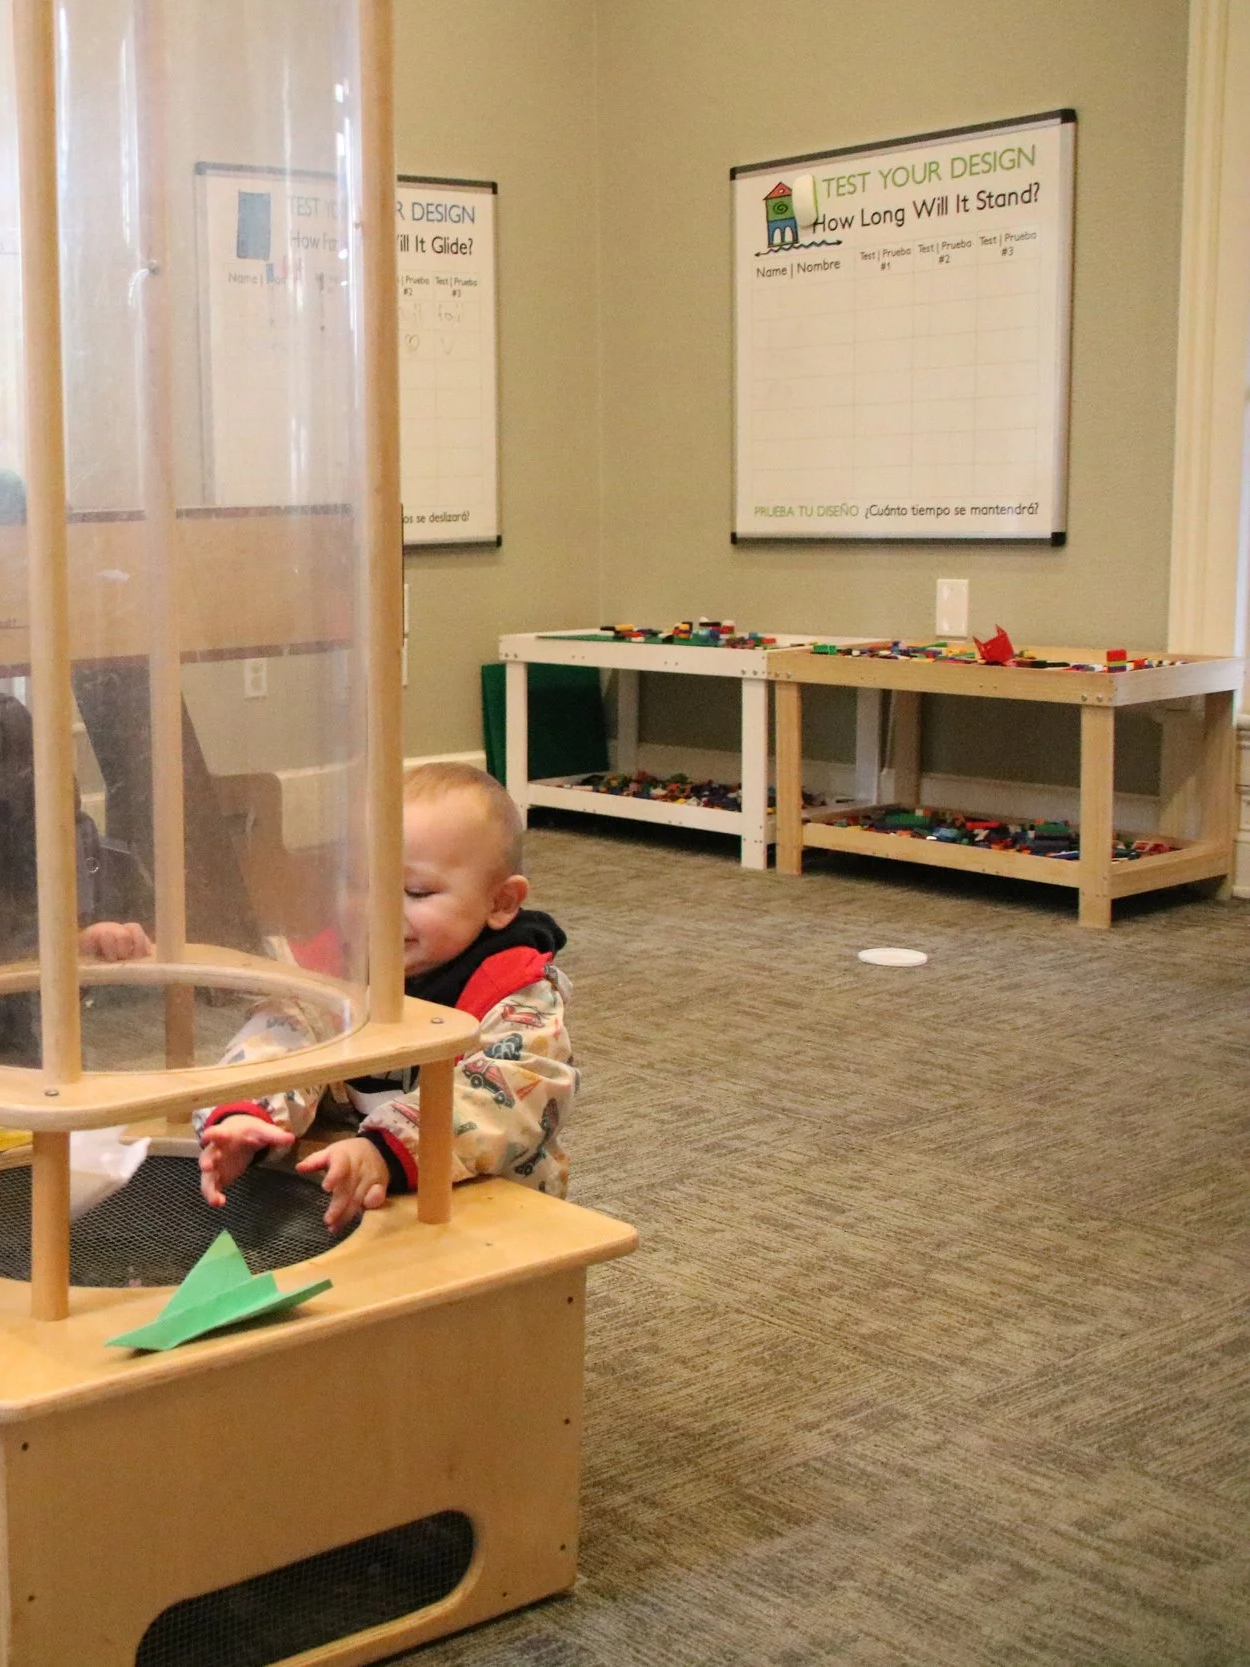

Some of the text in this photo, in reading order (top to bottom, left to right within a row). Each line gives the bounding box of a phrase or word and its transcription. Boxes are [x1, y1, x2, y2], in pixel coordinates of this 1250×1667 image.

[822, 144, 1036, 198] TEST YOUR DESIGN
[412, 202, 475, 224] DESIGN
[813, 182, 1040, 234] How Long Will It Stand?
[397, 234, 409, 252] ill
[416, 235, 426, 253] It
[431, 236, 474, 255] Glide?
[918, 243, 935, 253] Test
[941, 240, 973, 251] Prueba
[979, 235, 997, 246] Test
[1004, 231, 1037, 242] Prueba
[860, 251, 876, 261] Test
[882, 248, 912, 258] Prueba
[938, 254, 950, 264] #2
[1001, 247, 1014, 256] #3
[756, 266, 788, 278] Name
[797, 260, 841, 273] Nombre
[754, 502, 1039, 519] PRUEBA TU DISEÑO ¿Cuánto tiempo se mantendrá?
